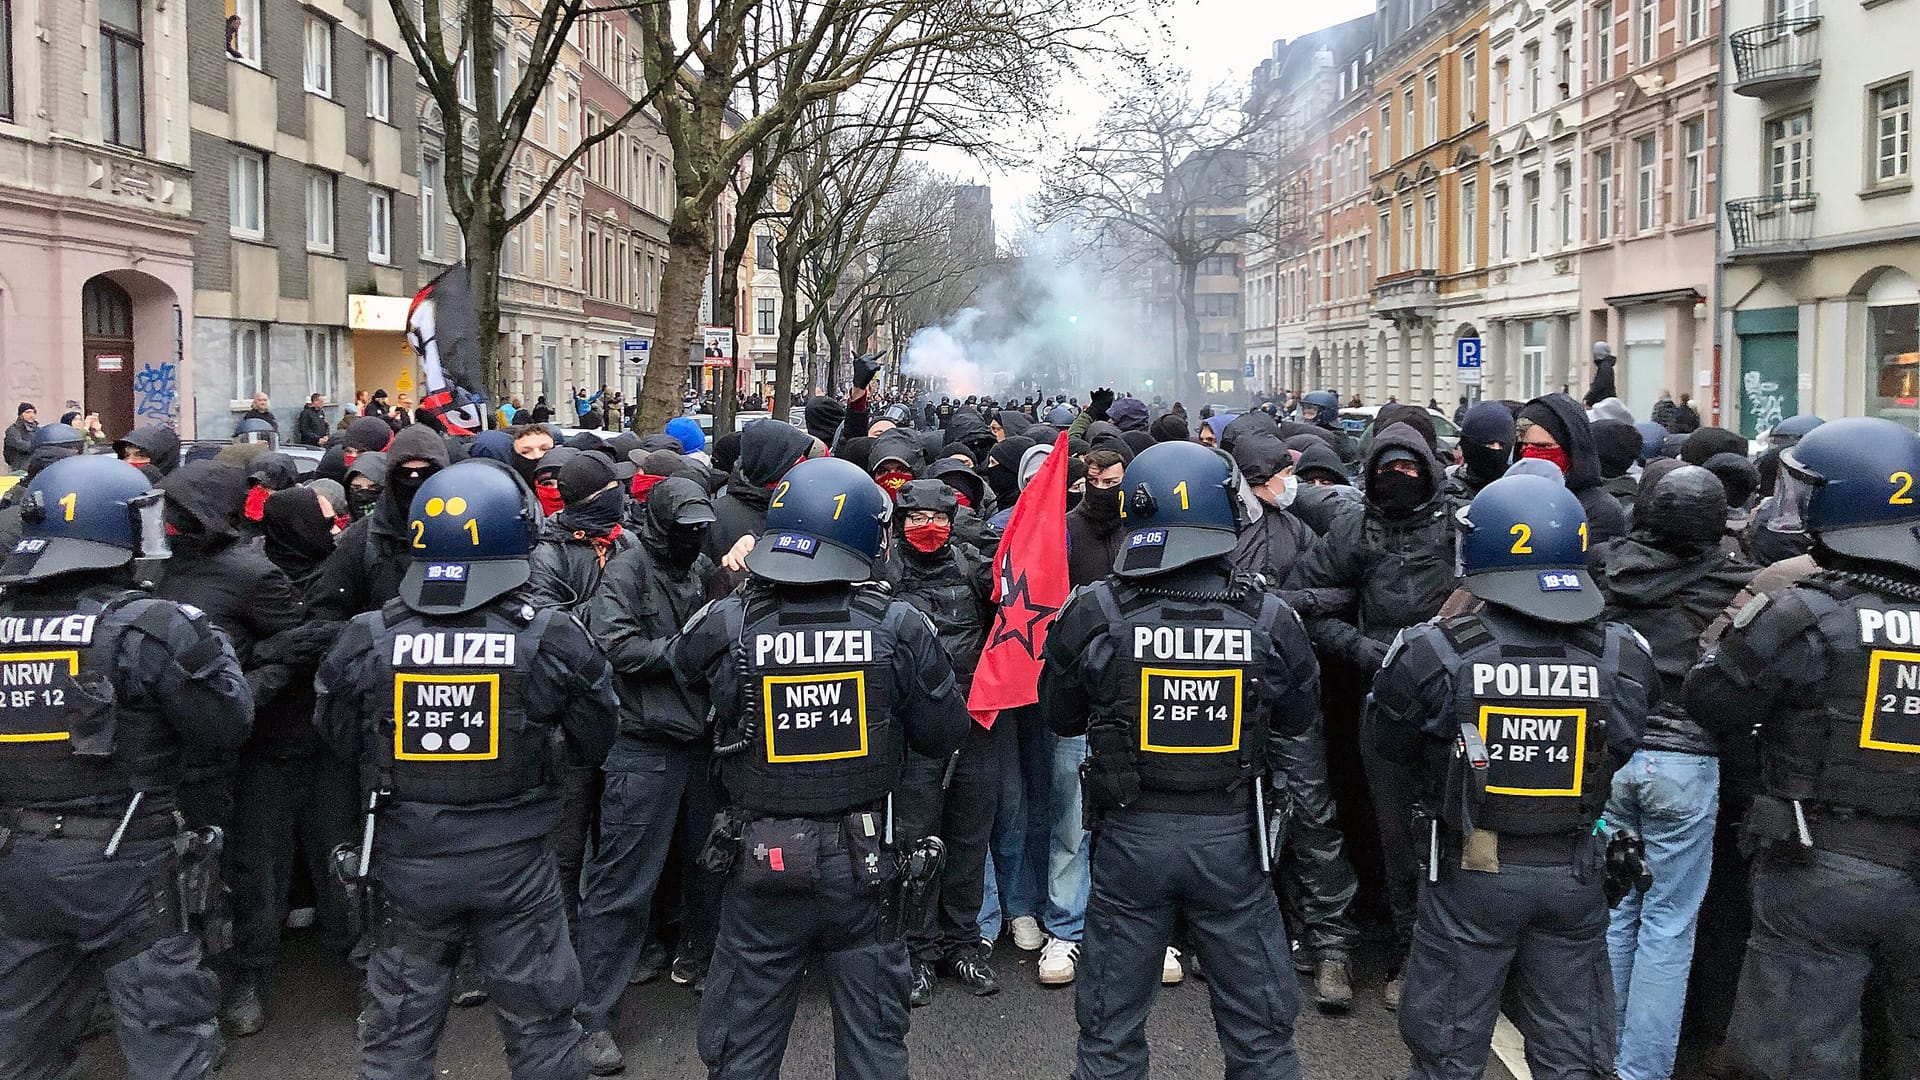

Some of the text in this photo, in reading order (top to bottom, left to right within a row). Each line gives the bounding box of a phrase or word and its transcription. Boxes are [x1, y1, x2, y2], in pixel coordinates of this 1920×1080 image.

[1462, 342, 1476, 364] P
[772, 481, 790, 508] 2
[1173, 481, 1190, 511] 1
[1888, 472, 1913, 505] 2
[59, 492, 77, 522] 1
[832, 493, 847, 520] 1
[410, 519, 427, 549] 2
[463, 519, 480, 545] 1
[1132, 531, 1162, 547] 19-05
[1509, 523, 1532, 554] 2
[1578, 522, 1588, 552] 1
[0, 614, 97, 644] OLIZEI
[392, 632, 516, 666] POLIZEI
[756, 630, 872, 666] POLIZEI
[1134, 627, 1252, 661] POLIZEI
[3, 663, 54, 686] NRW
[1473, 663, 1599, 698] POLIZEI
[1896, 664, 1920, 690] N
[11, 691, 36, 708] BF
[41, 689, 65, 706] 12
[417, 685, 475, 707] NRW
[785, 683, 841, 707] NRW
[1164, 679, 1219, 700] NRW
[1153, 705, 1228, 722] 2 BF 14
[1881, 694, 1897, 712] 2
[407, 711, 484, 728] 2 BF 14
[778, 709, 852, 729] 2 BF 14
[1502, 718, 1562, 742] NRW
[1490, 744, 1570, 762] 2 BF 14
